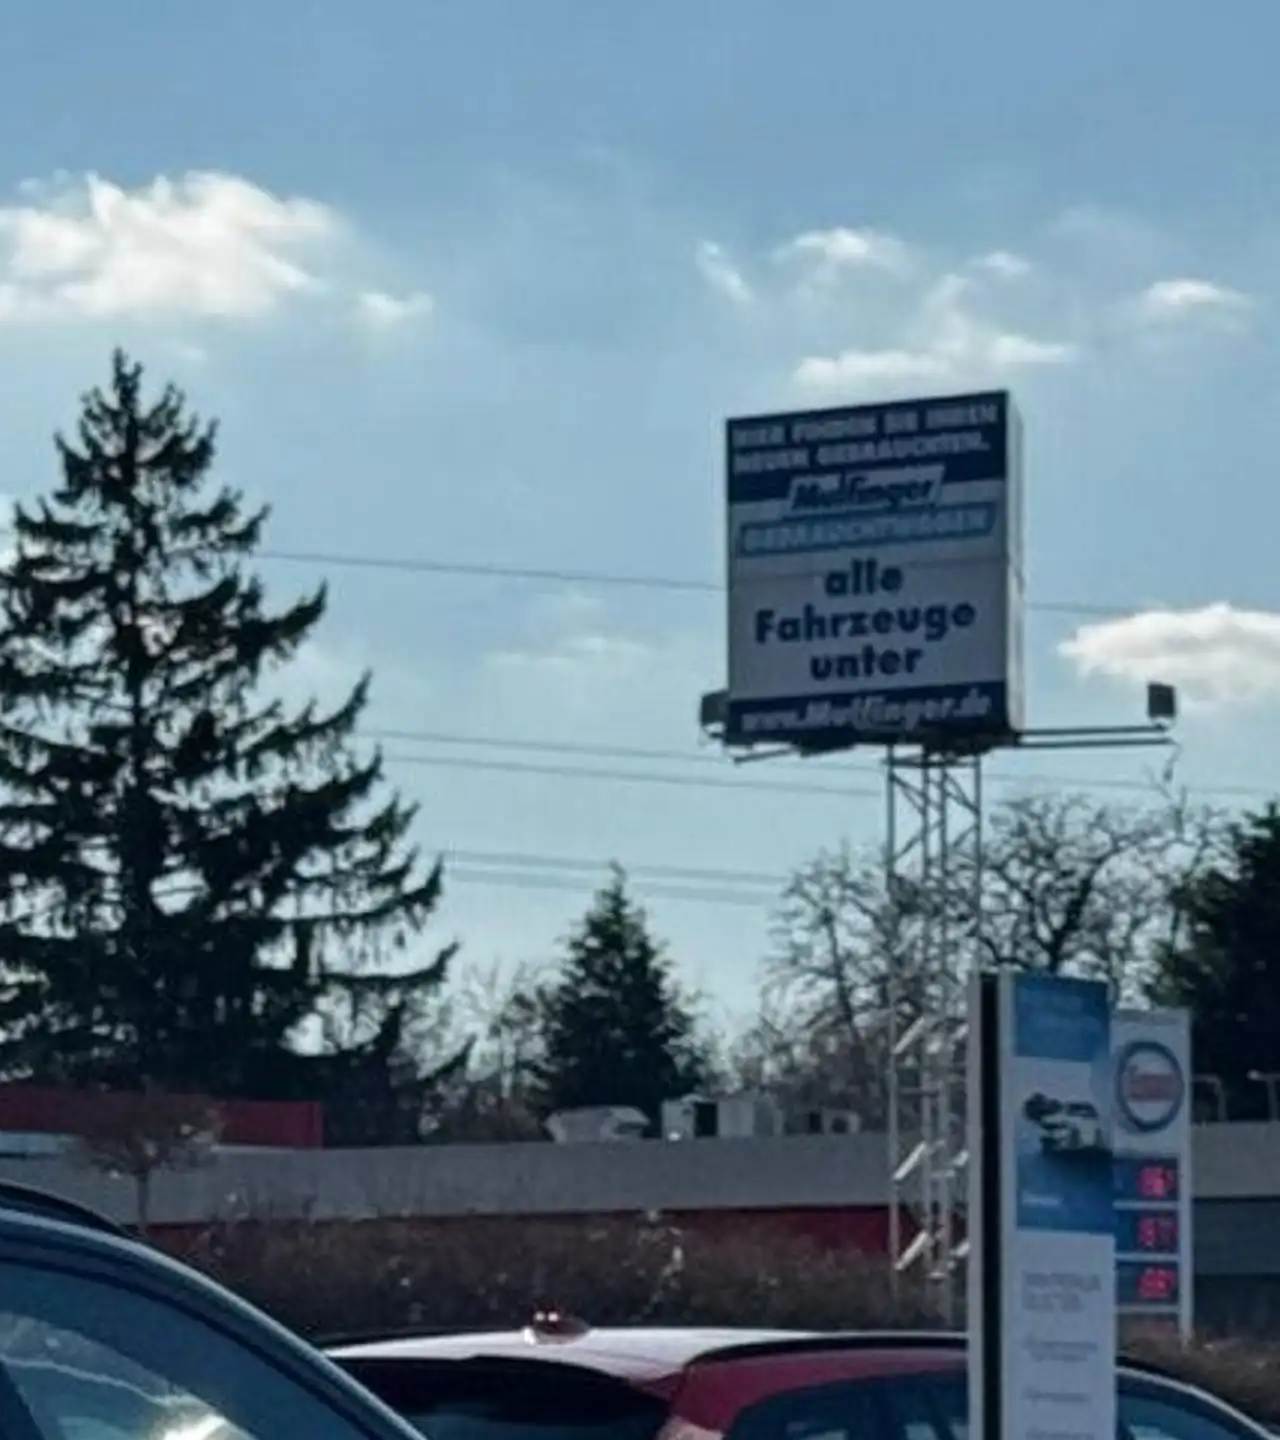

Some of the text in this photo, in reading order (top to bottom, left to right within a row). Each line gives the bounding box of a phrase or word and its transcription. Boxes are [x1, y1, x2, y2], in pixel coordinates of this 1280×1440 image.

[824, 558, 905, 597] alle
[754, 602, 977, 644] Fahrzeuge
[810, 645, 923, 681] unter
